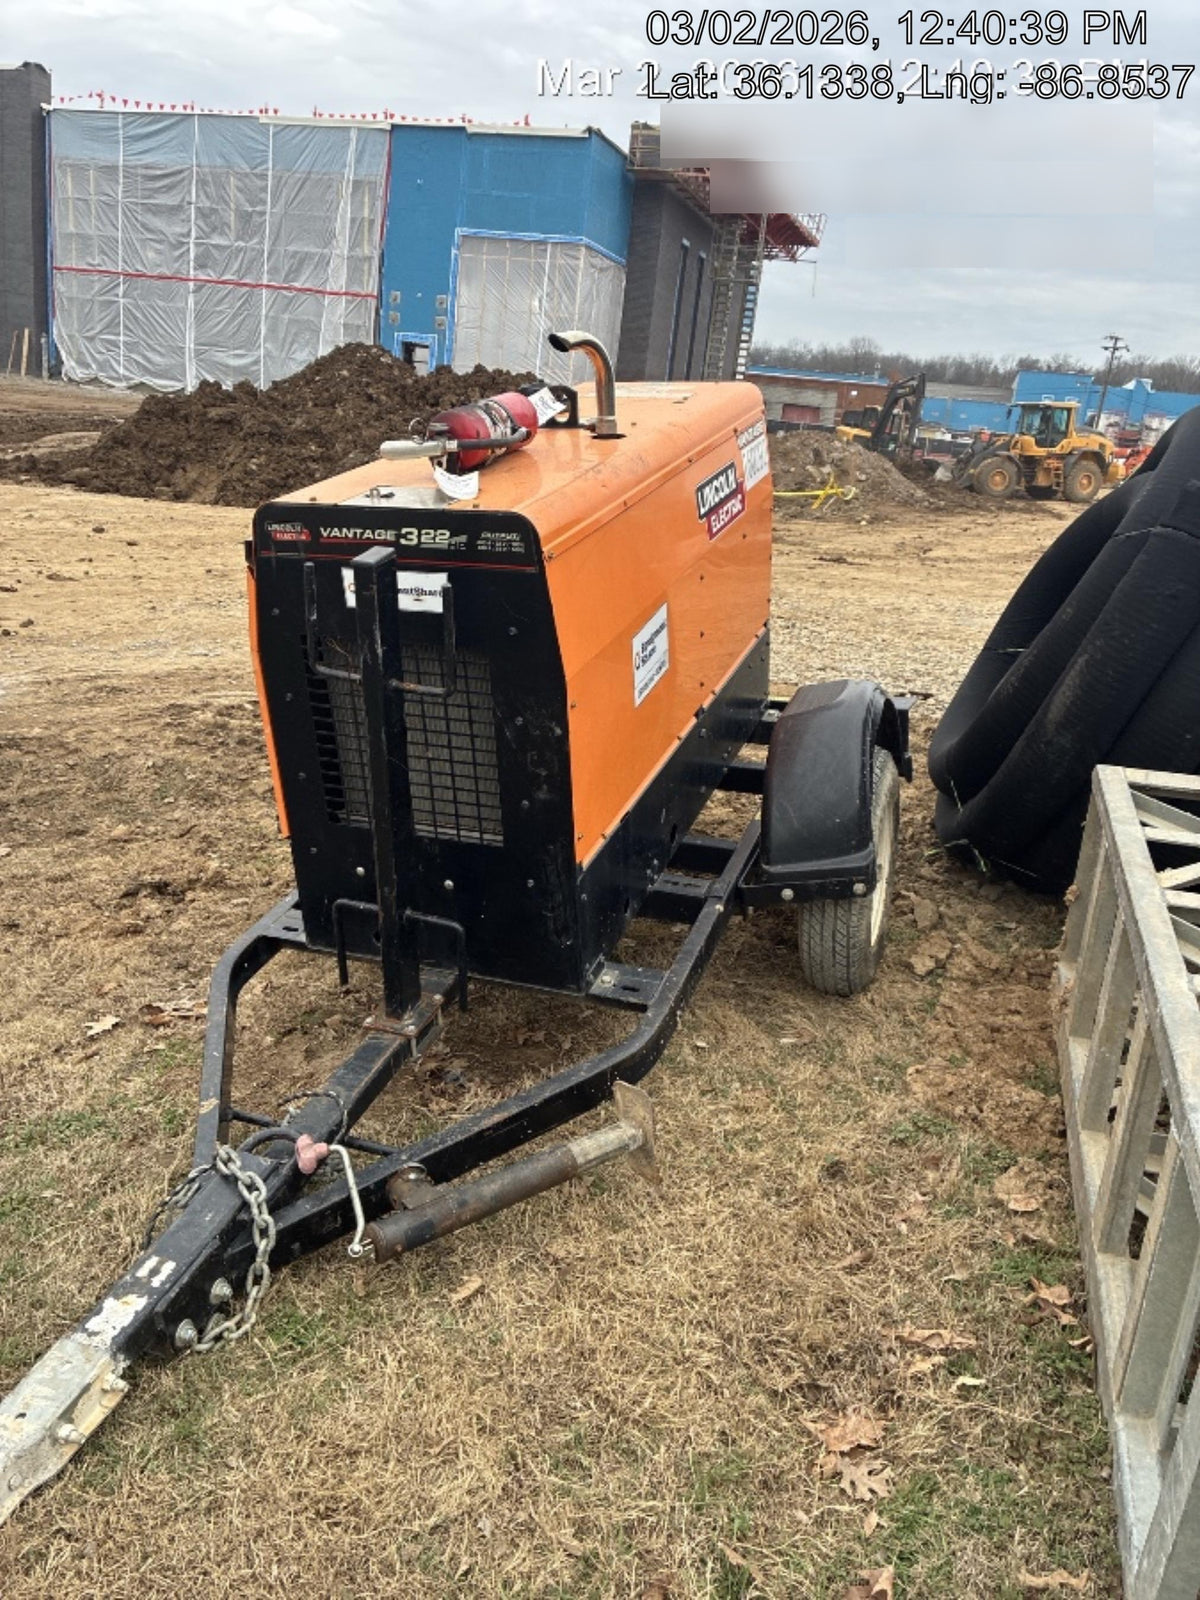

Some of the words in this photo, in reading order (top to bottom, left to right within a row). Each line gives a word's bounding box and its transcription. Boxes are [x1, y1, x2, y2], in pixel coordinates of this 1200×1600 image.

[697, 466, 737, 516] LINCOLN
[710, 493, 744, 535] ELECTRIC
[319, 526, 398, 542] VANTAGE
[399, 527, 451, 546] 322
